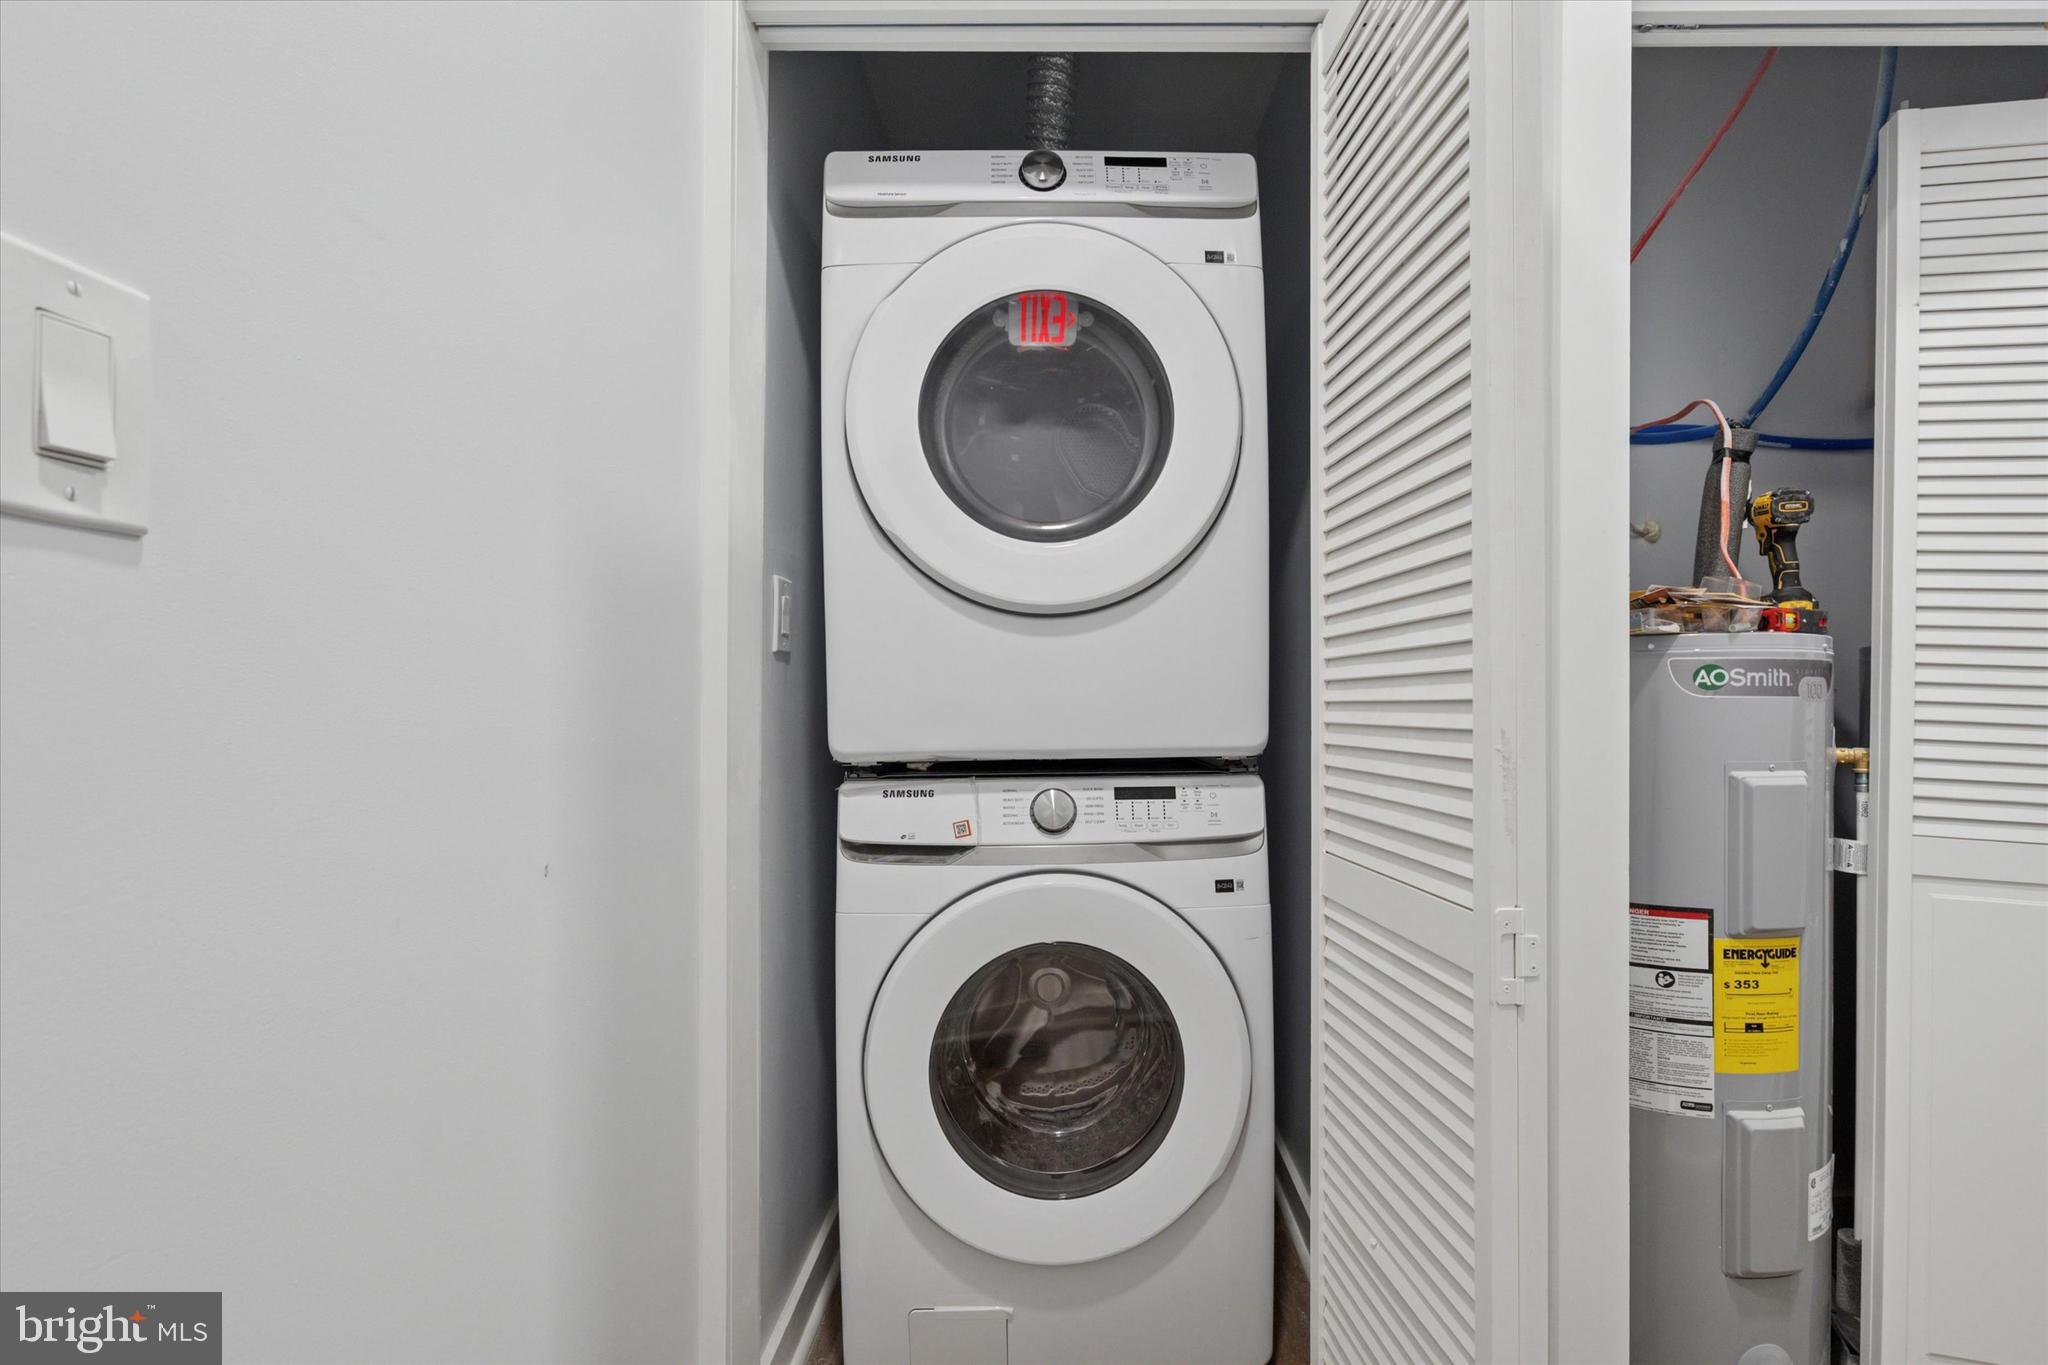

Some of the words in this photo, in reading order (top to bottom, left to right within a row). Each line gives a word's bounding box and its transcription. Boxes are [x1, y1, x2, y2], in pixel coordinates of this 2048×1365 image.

[868, 154, 921, 163] SAMSUNG
[882, 789, 935, 799] SAMSUNG
[1629, 907, 1650, 916] NGER
[1723, 947, 1797, 962] ENERGYGUIDE
[1734, 979, 1760, 989] 353
